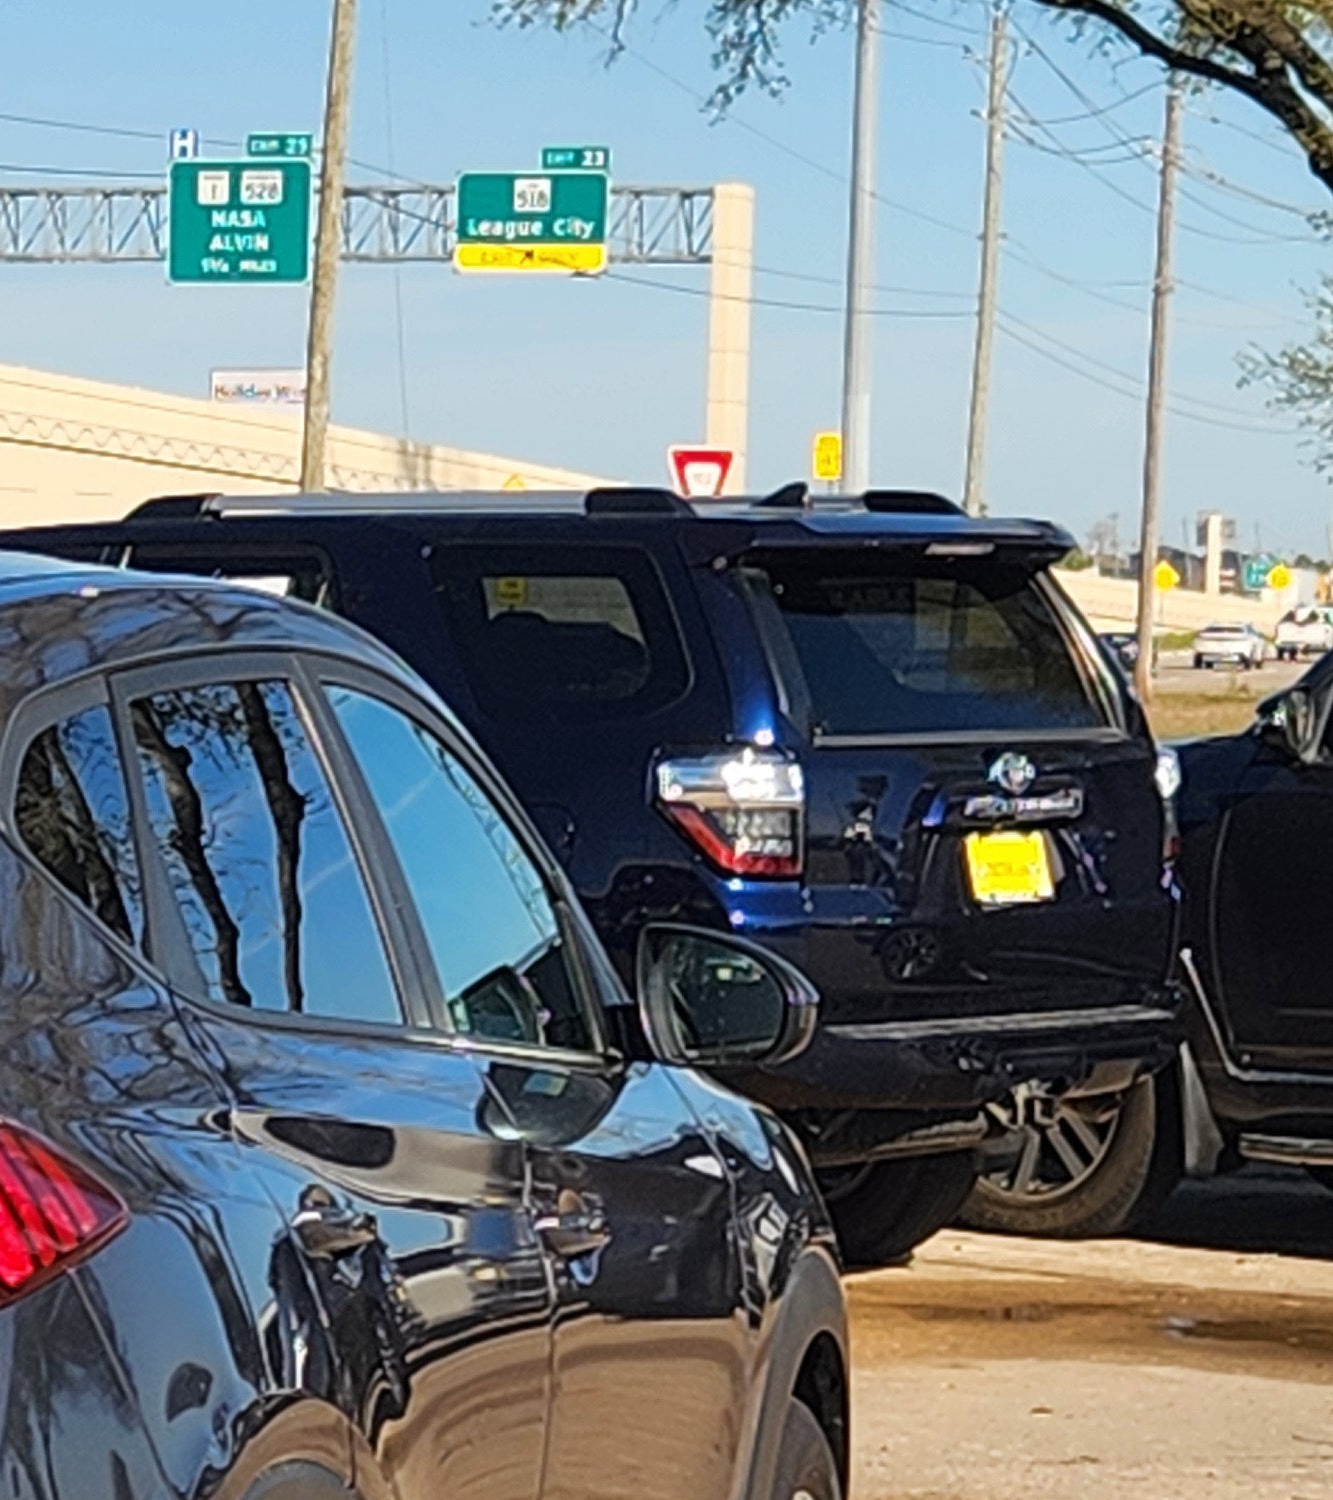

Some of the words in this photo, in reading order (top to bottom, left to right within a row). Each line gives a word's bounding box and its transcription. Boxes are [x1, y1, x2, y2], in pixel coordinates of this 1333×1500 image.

[173, 130, 195, 158] H
[581, 151, 605, 167] 23
[245, 182, 279, 200] 528
[516, 189, 549, 209] 518
[211, 210, 266, 228] NASA
[466, 217, 543, 241] League
[552, 216, 596, 240] City
[208, 233, 270, 252] ALVIN
